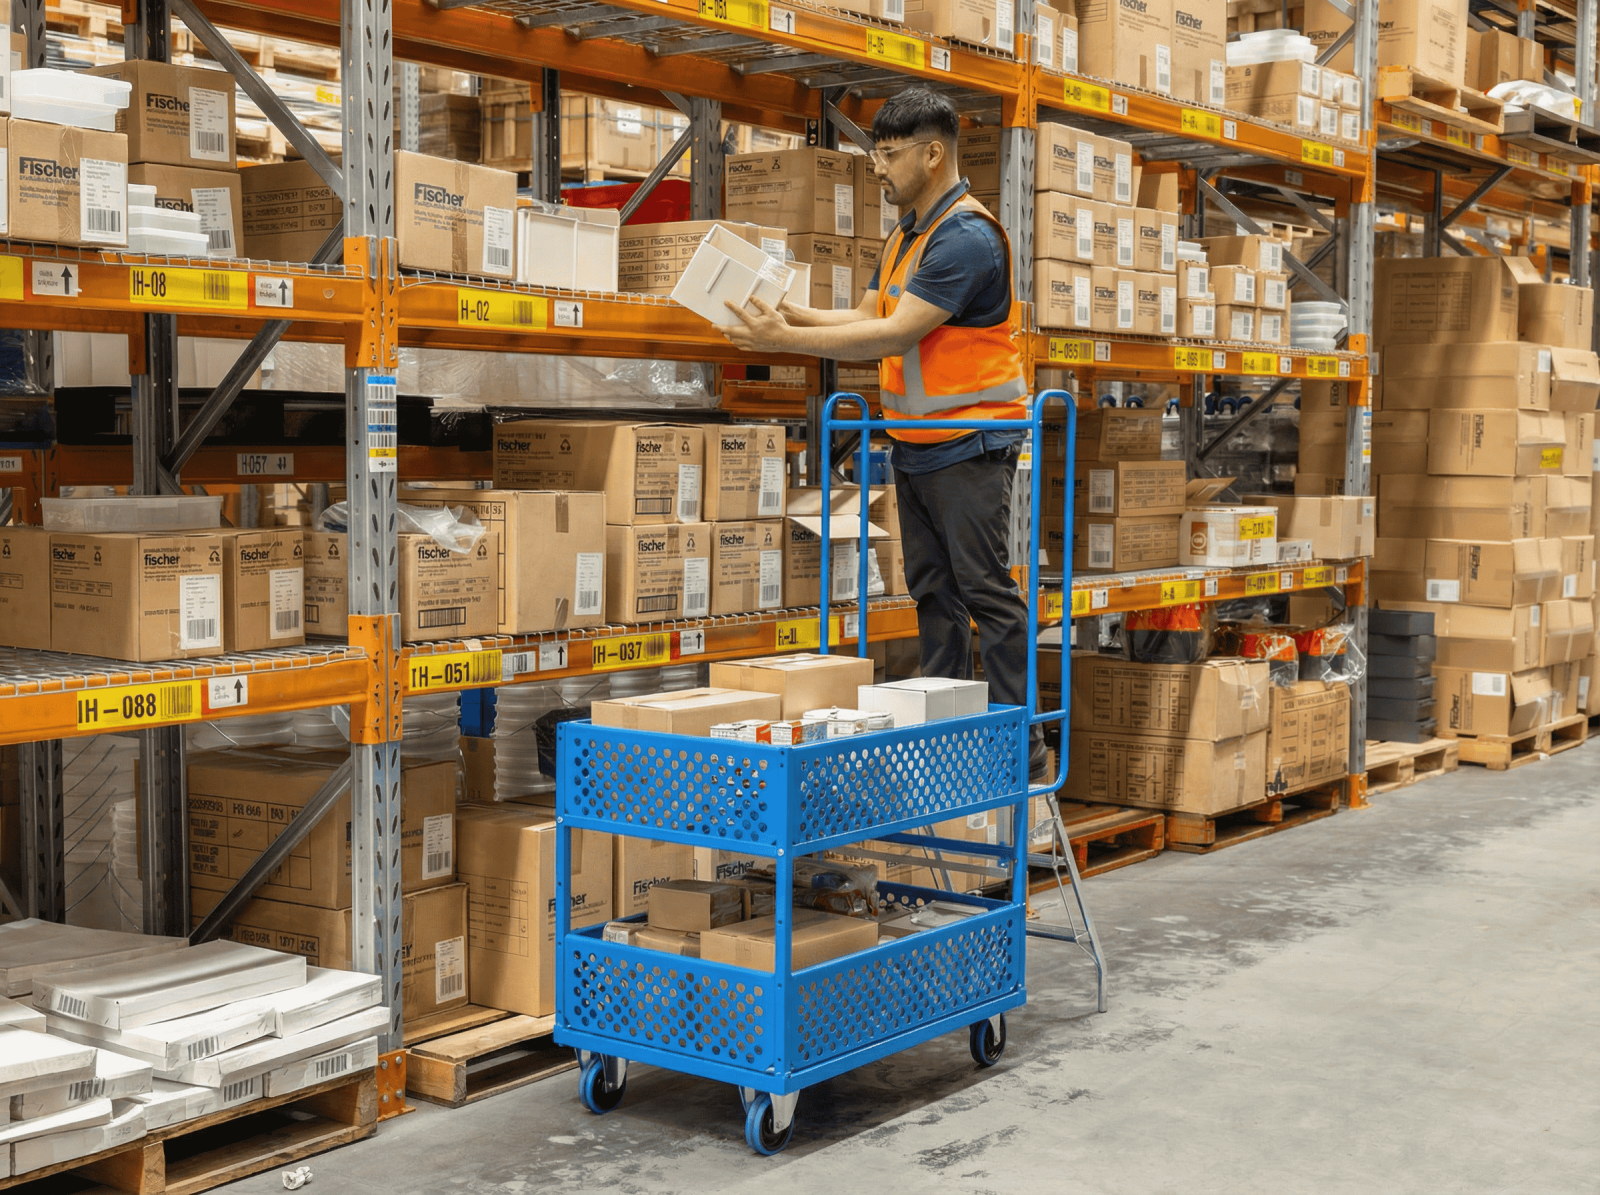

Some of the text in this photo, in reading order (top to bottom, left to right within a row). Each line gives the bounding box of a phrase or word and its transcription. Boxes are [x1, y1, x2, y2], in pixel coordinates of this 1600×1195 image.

[146, 92, 190, 112] Fische
[19, 156, 80, 180] Fischer
[414, 183, 465, 208] Fischer
[132, 270, 167, 298] IH-08
[461, 299, 490, 322] H-02
[636, 441, 662, 453] fischer
[721, 439, 747, 451] fischer
[240, 549, 271, 562] fischer
[418, 546, 451, 560] fischer
[638, 540, 666, 552] fischer
[144, 553, 181, 567] fischer
[593, 641, 643, 665] IH-037
[412, 661, 471, 688] IH-051
[77, 693, 157, 724] IH-088
[716, 860, 755, 880] Fischer
